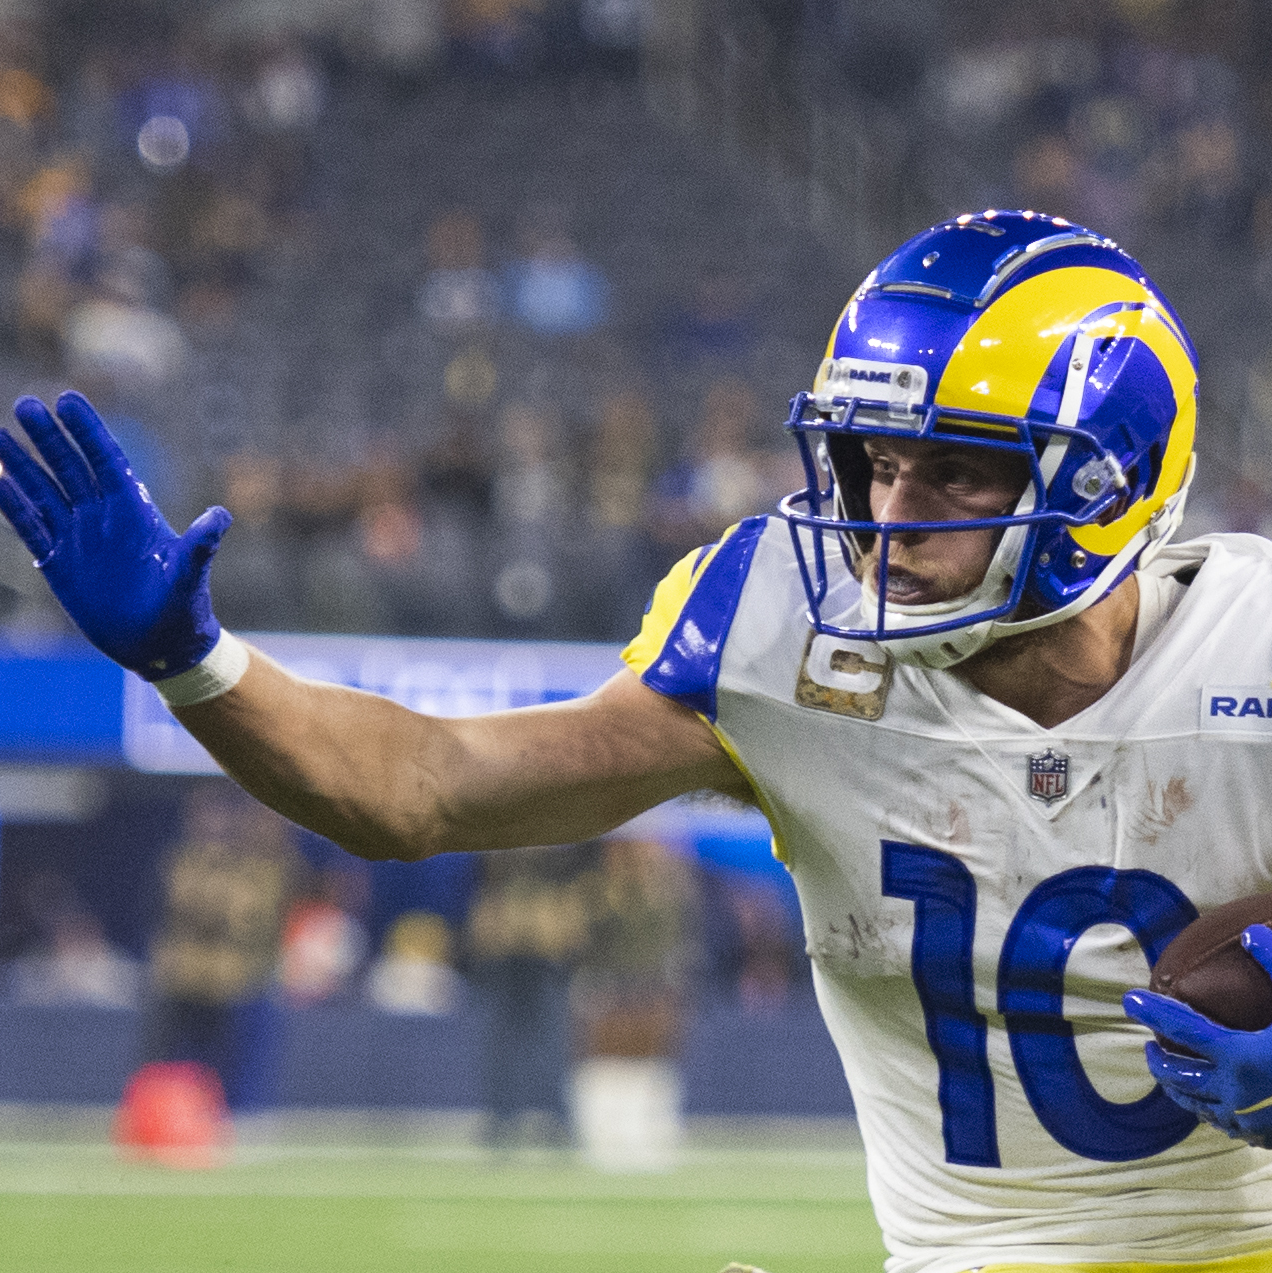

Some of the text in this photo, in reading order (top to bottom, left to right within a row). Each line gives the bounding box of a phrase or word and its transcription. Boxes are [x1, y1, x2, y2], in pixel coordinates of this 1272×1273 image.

[806, 633, 886, 694] C
[1033, 773, 1064, 796] NFL
[880, 839, 1204, 1168] 10
